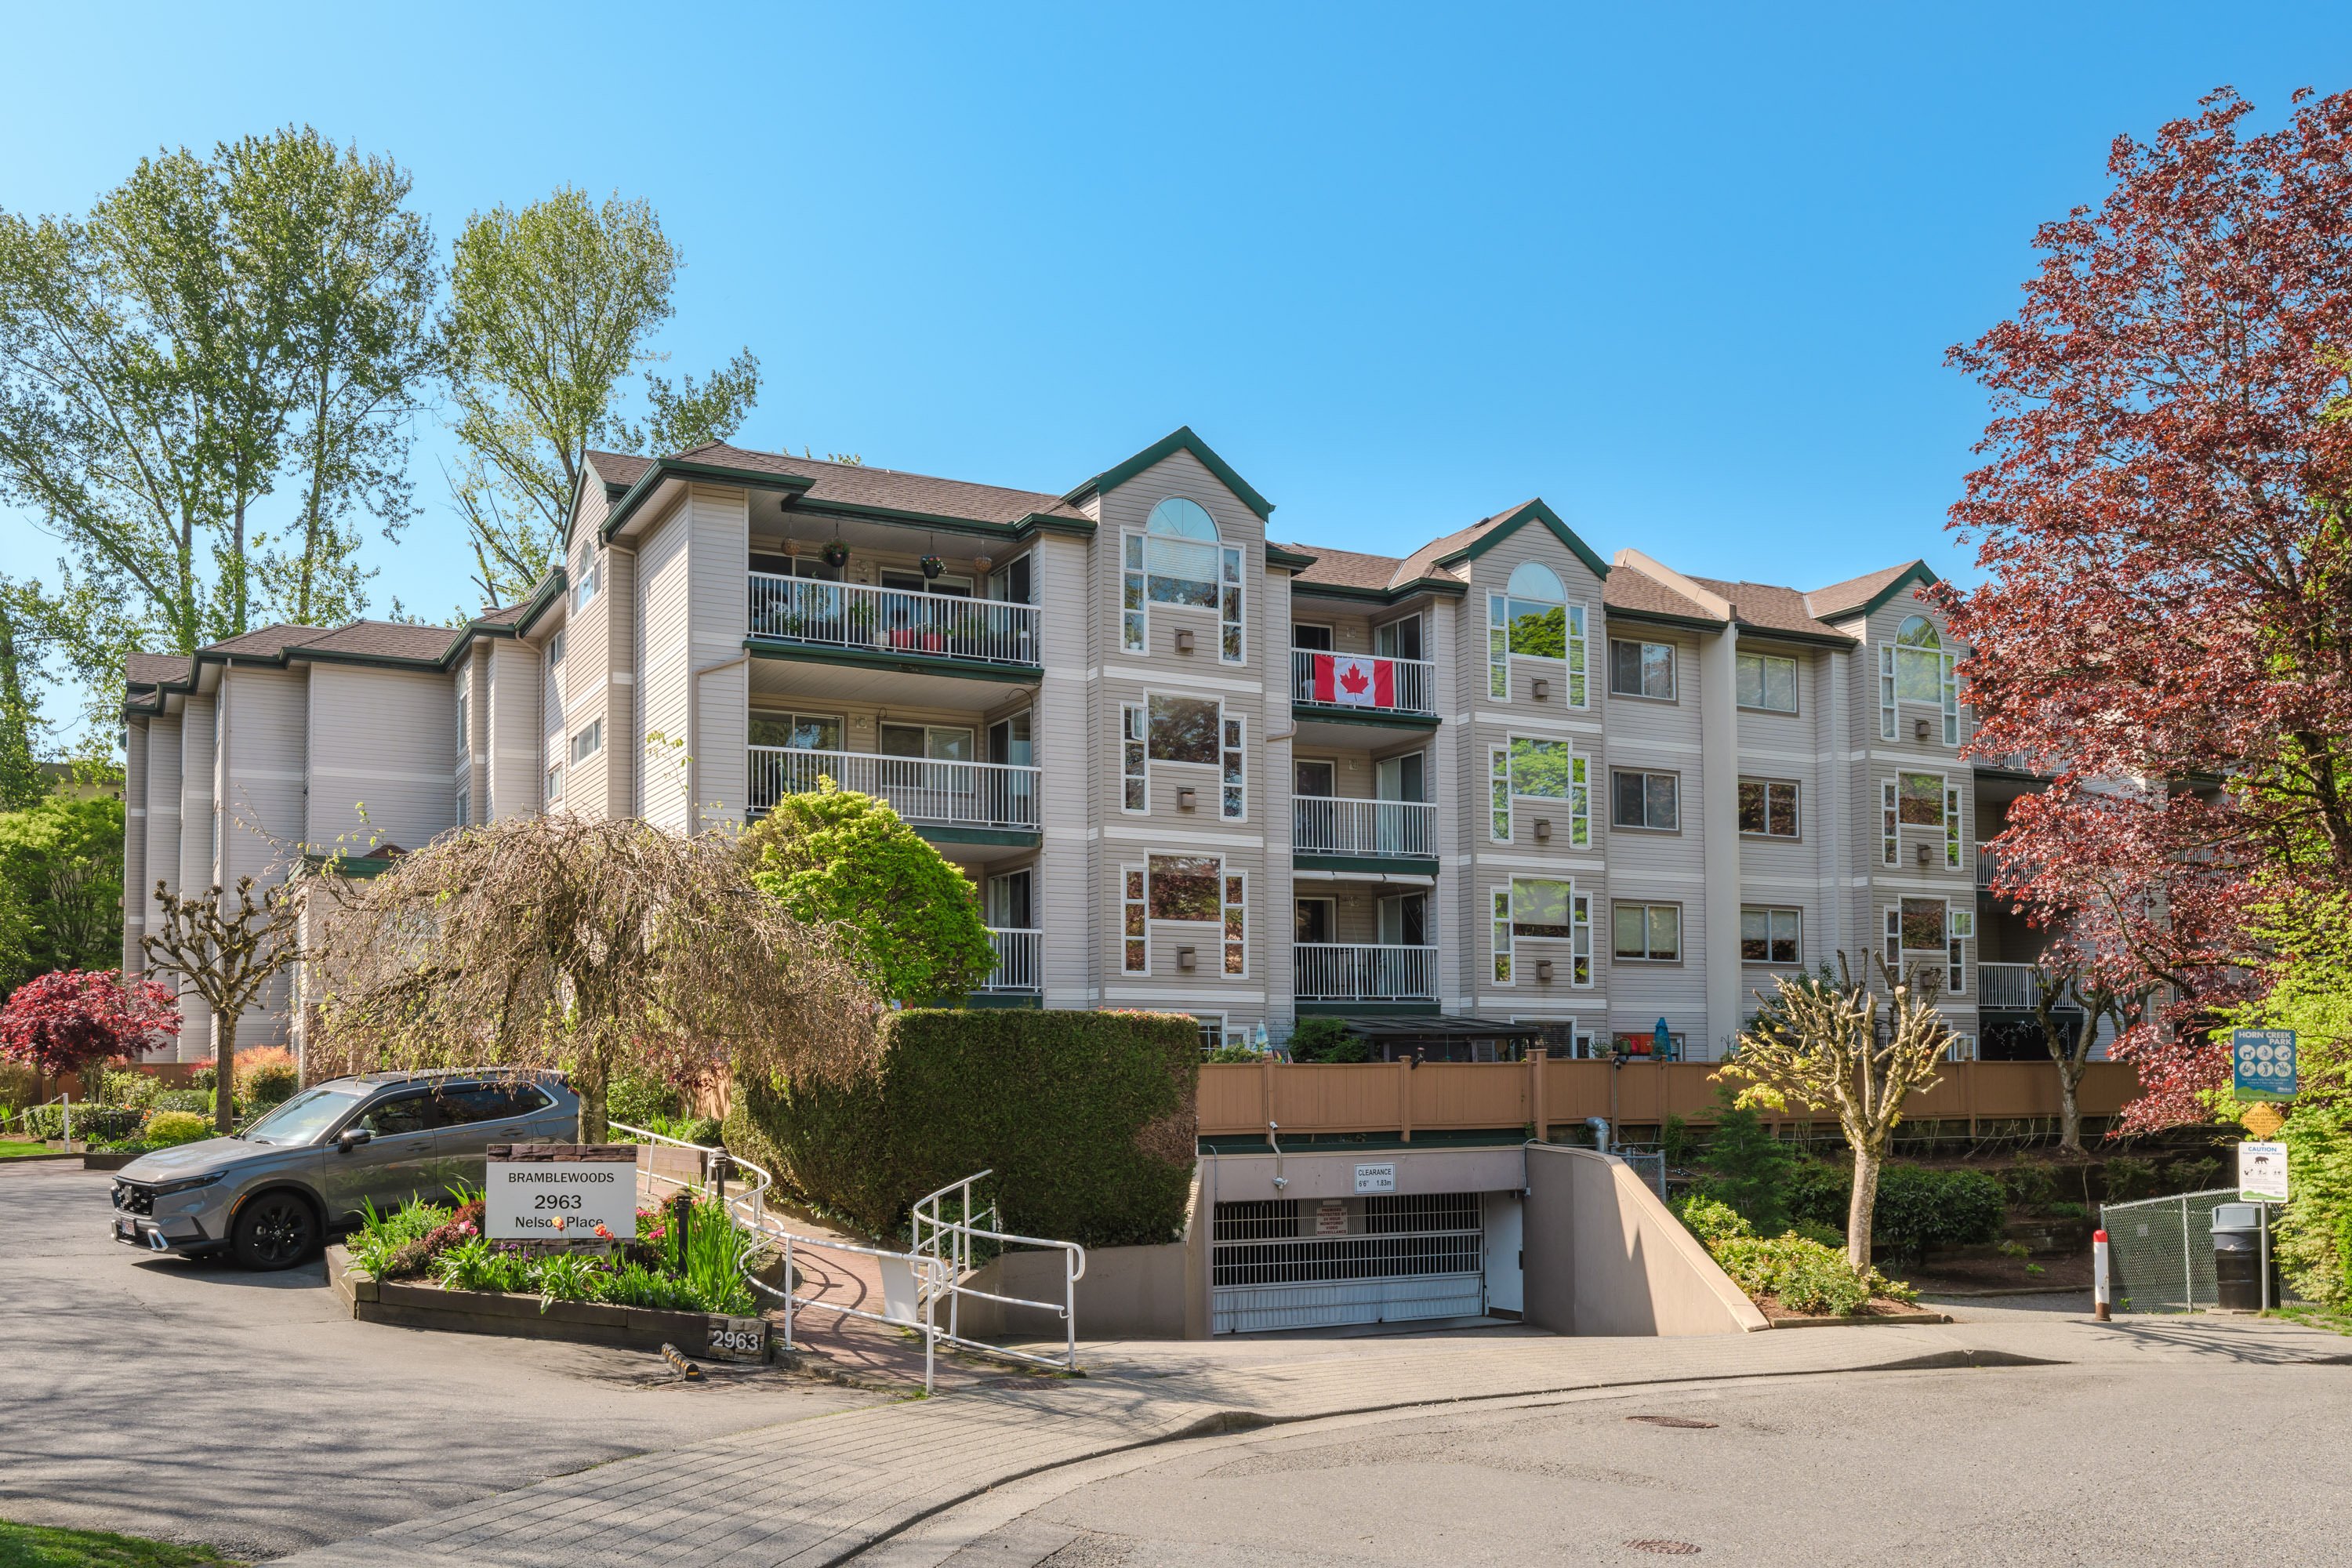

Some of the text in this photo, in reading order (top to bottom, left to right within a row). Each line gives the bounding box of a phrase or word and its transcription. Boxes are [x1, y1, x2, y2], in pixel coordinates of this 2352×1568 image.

[508, 1172, 615, 1183] BRAMBLEWOODS
[534, 1194, 582, 1210] 2963
[515, 1216, 563, 1228] Nelso
[712, 1330, 758, 1351] 2963
